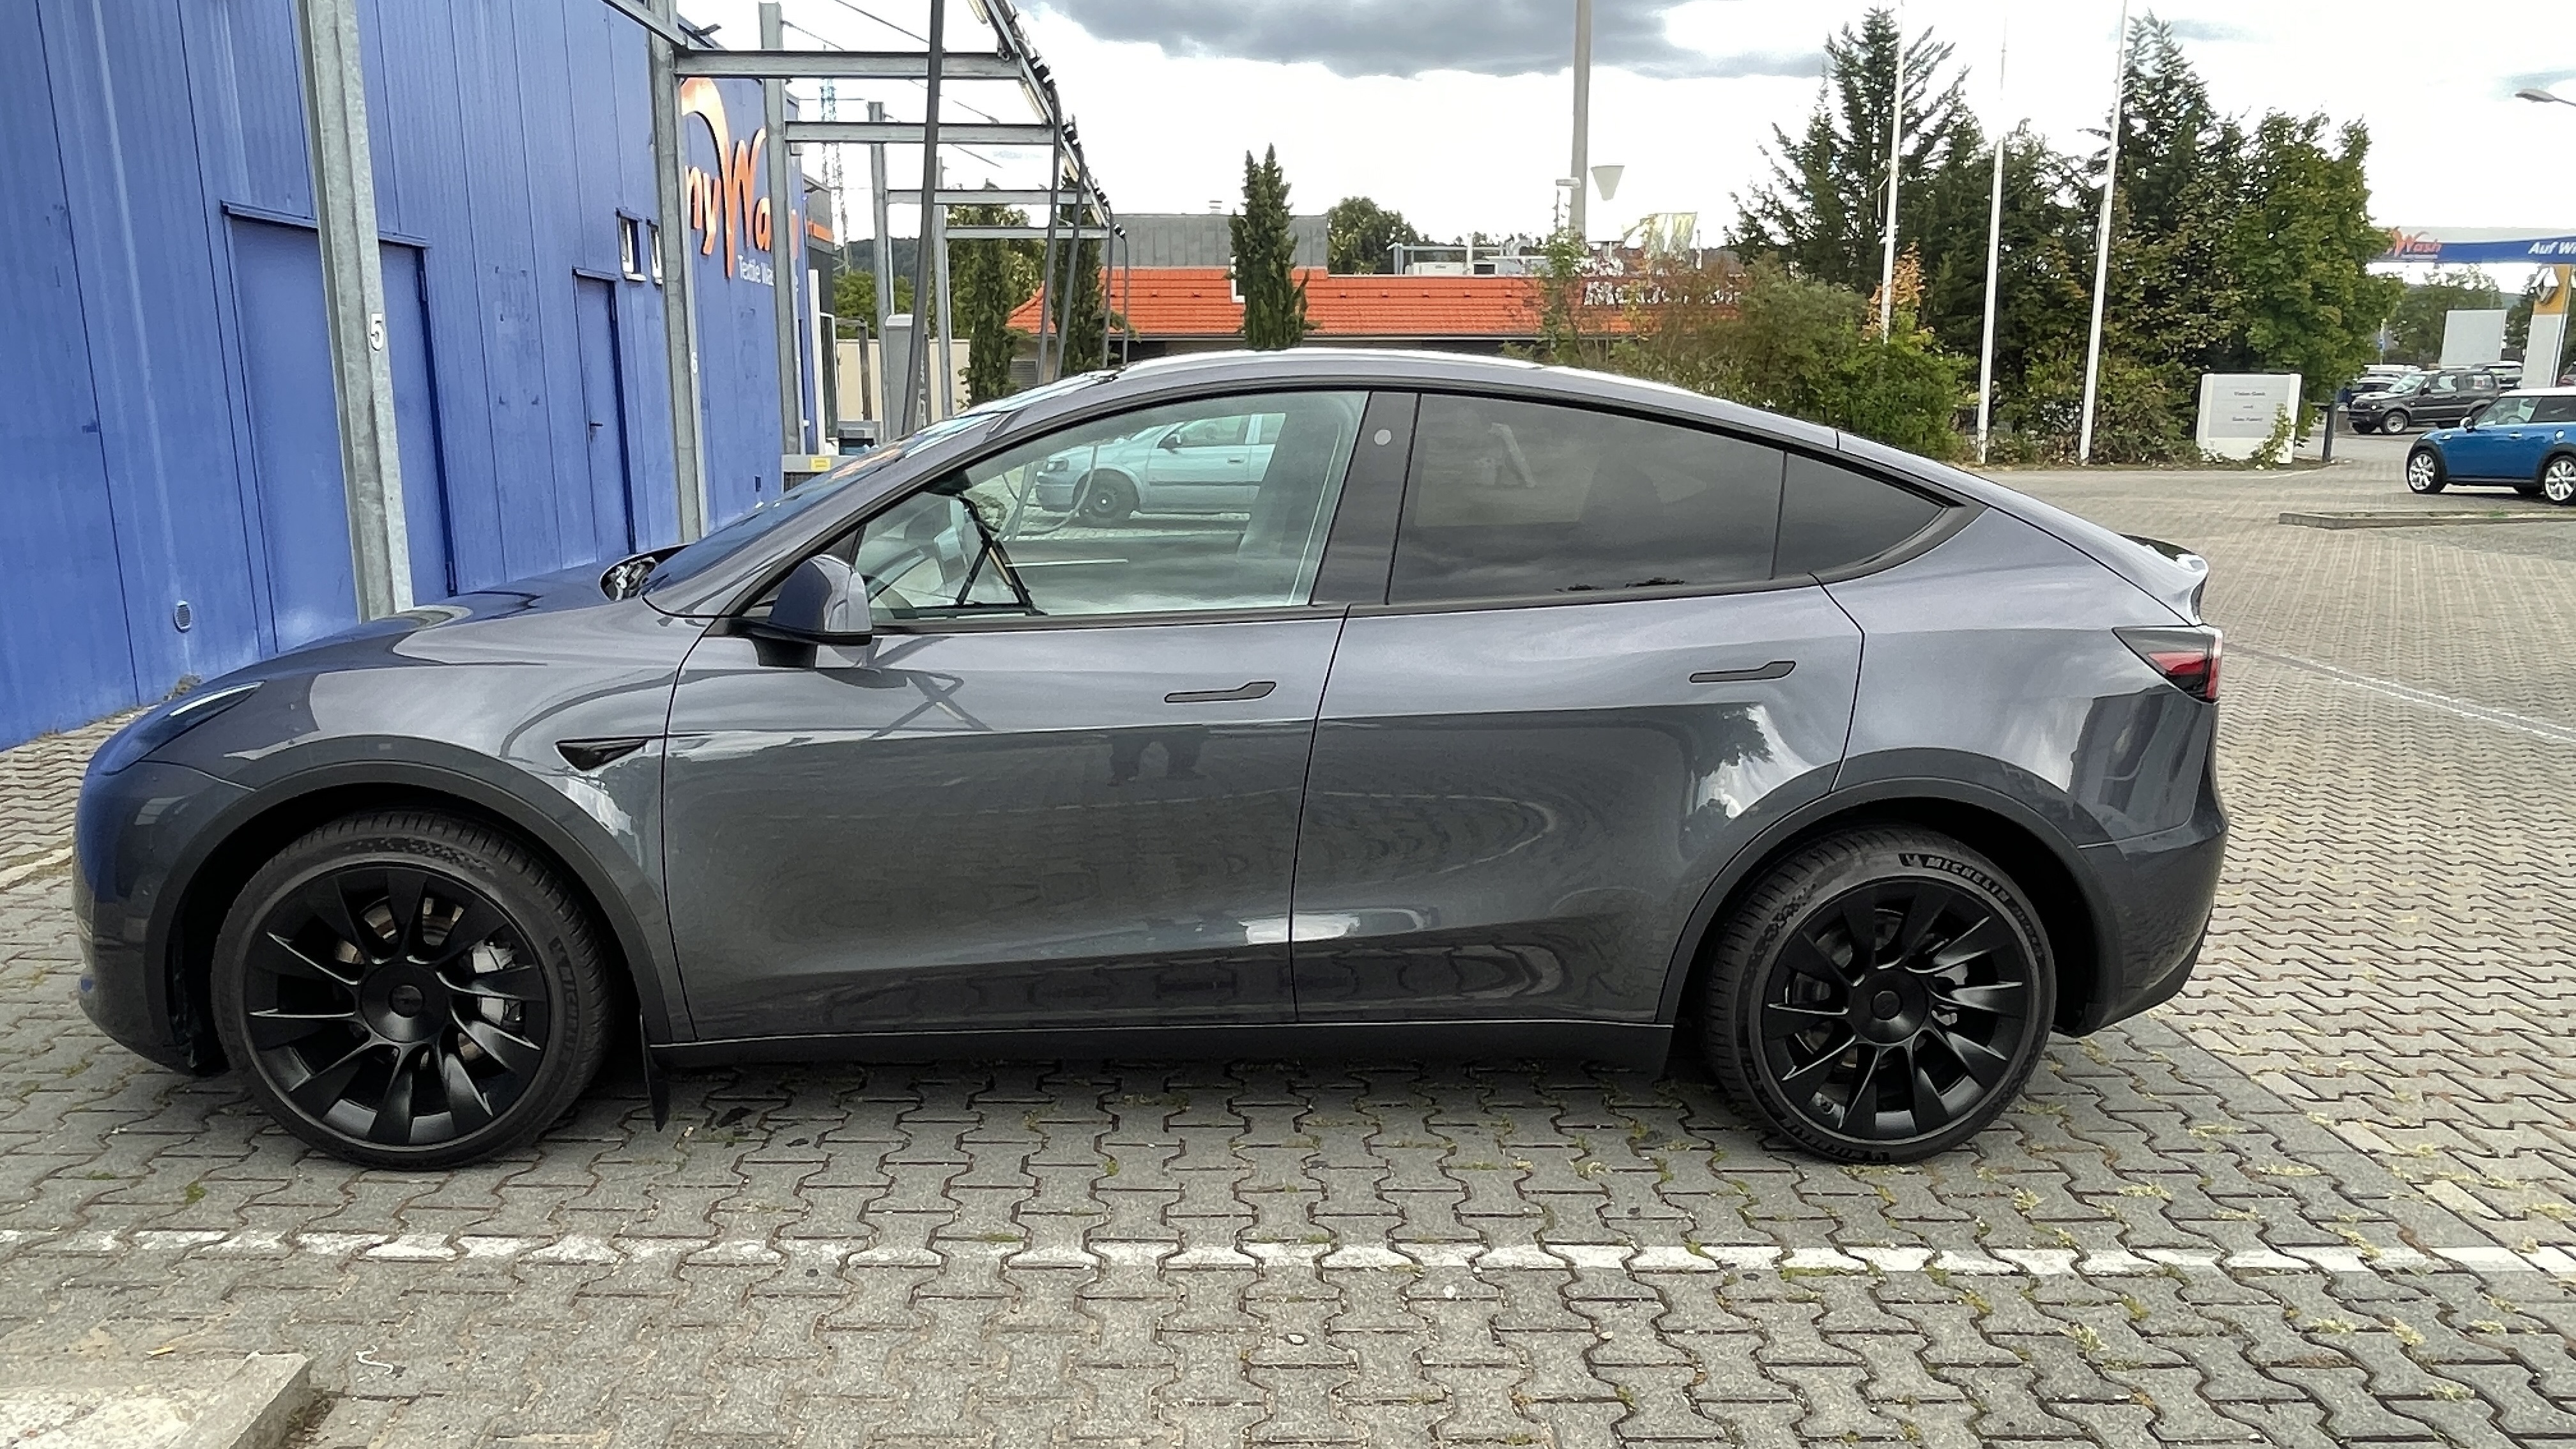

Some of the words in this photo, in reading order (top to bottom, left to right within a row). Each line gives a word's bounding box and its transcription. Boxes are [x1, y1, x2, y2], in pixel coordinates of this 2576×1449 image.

[2527, 241, 2559, 254] Auf
[370, 313, 384, 351] 5
[1926, 857, 2011, 902] MICHELIN
